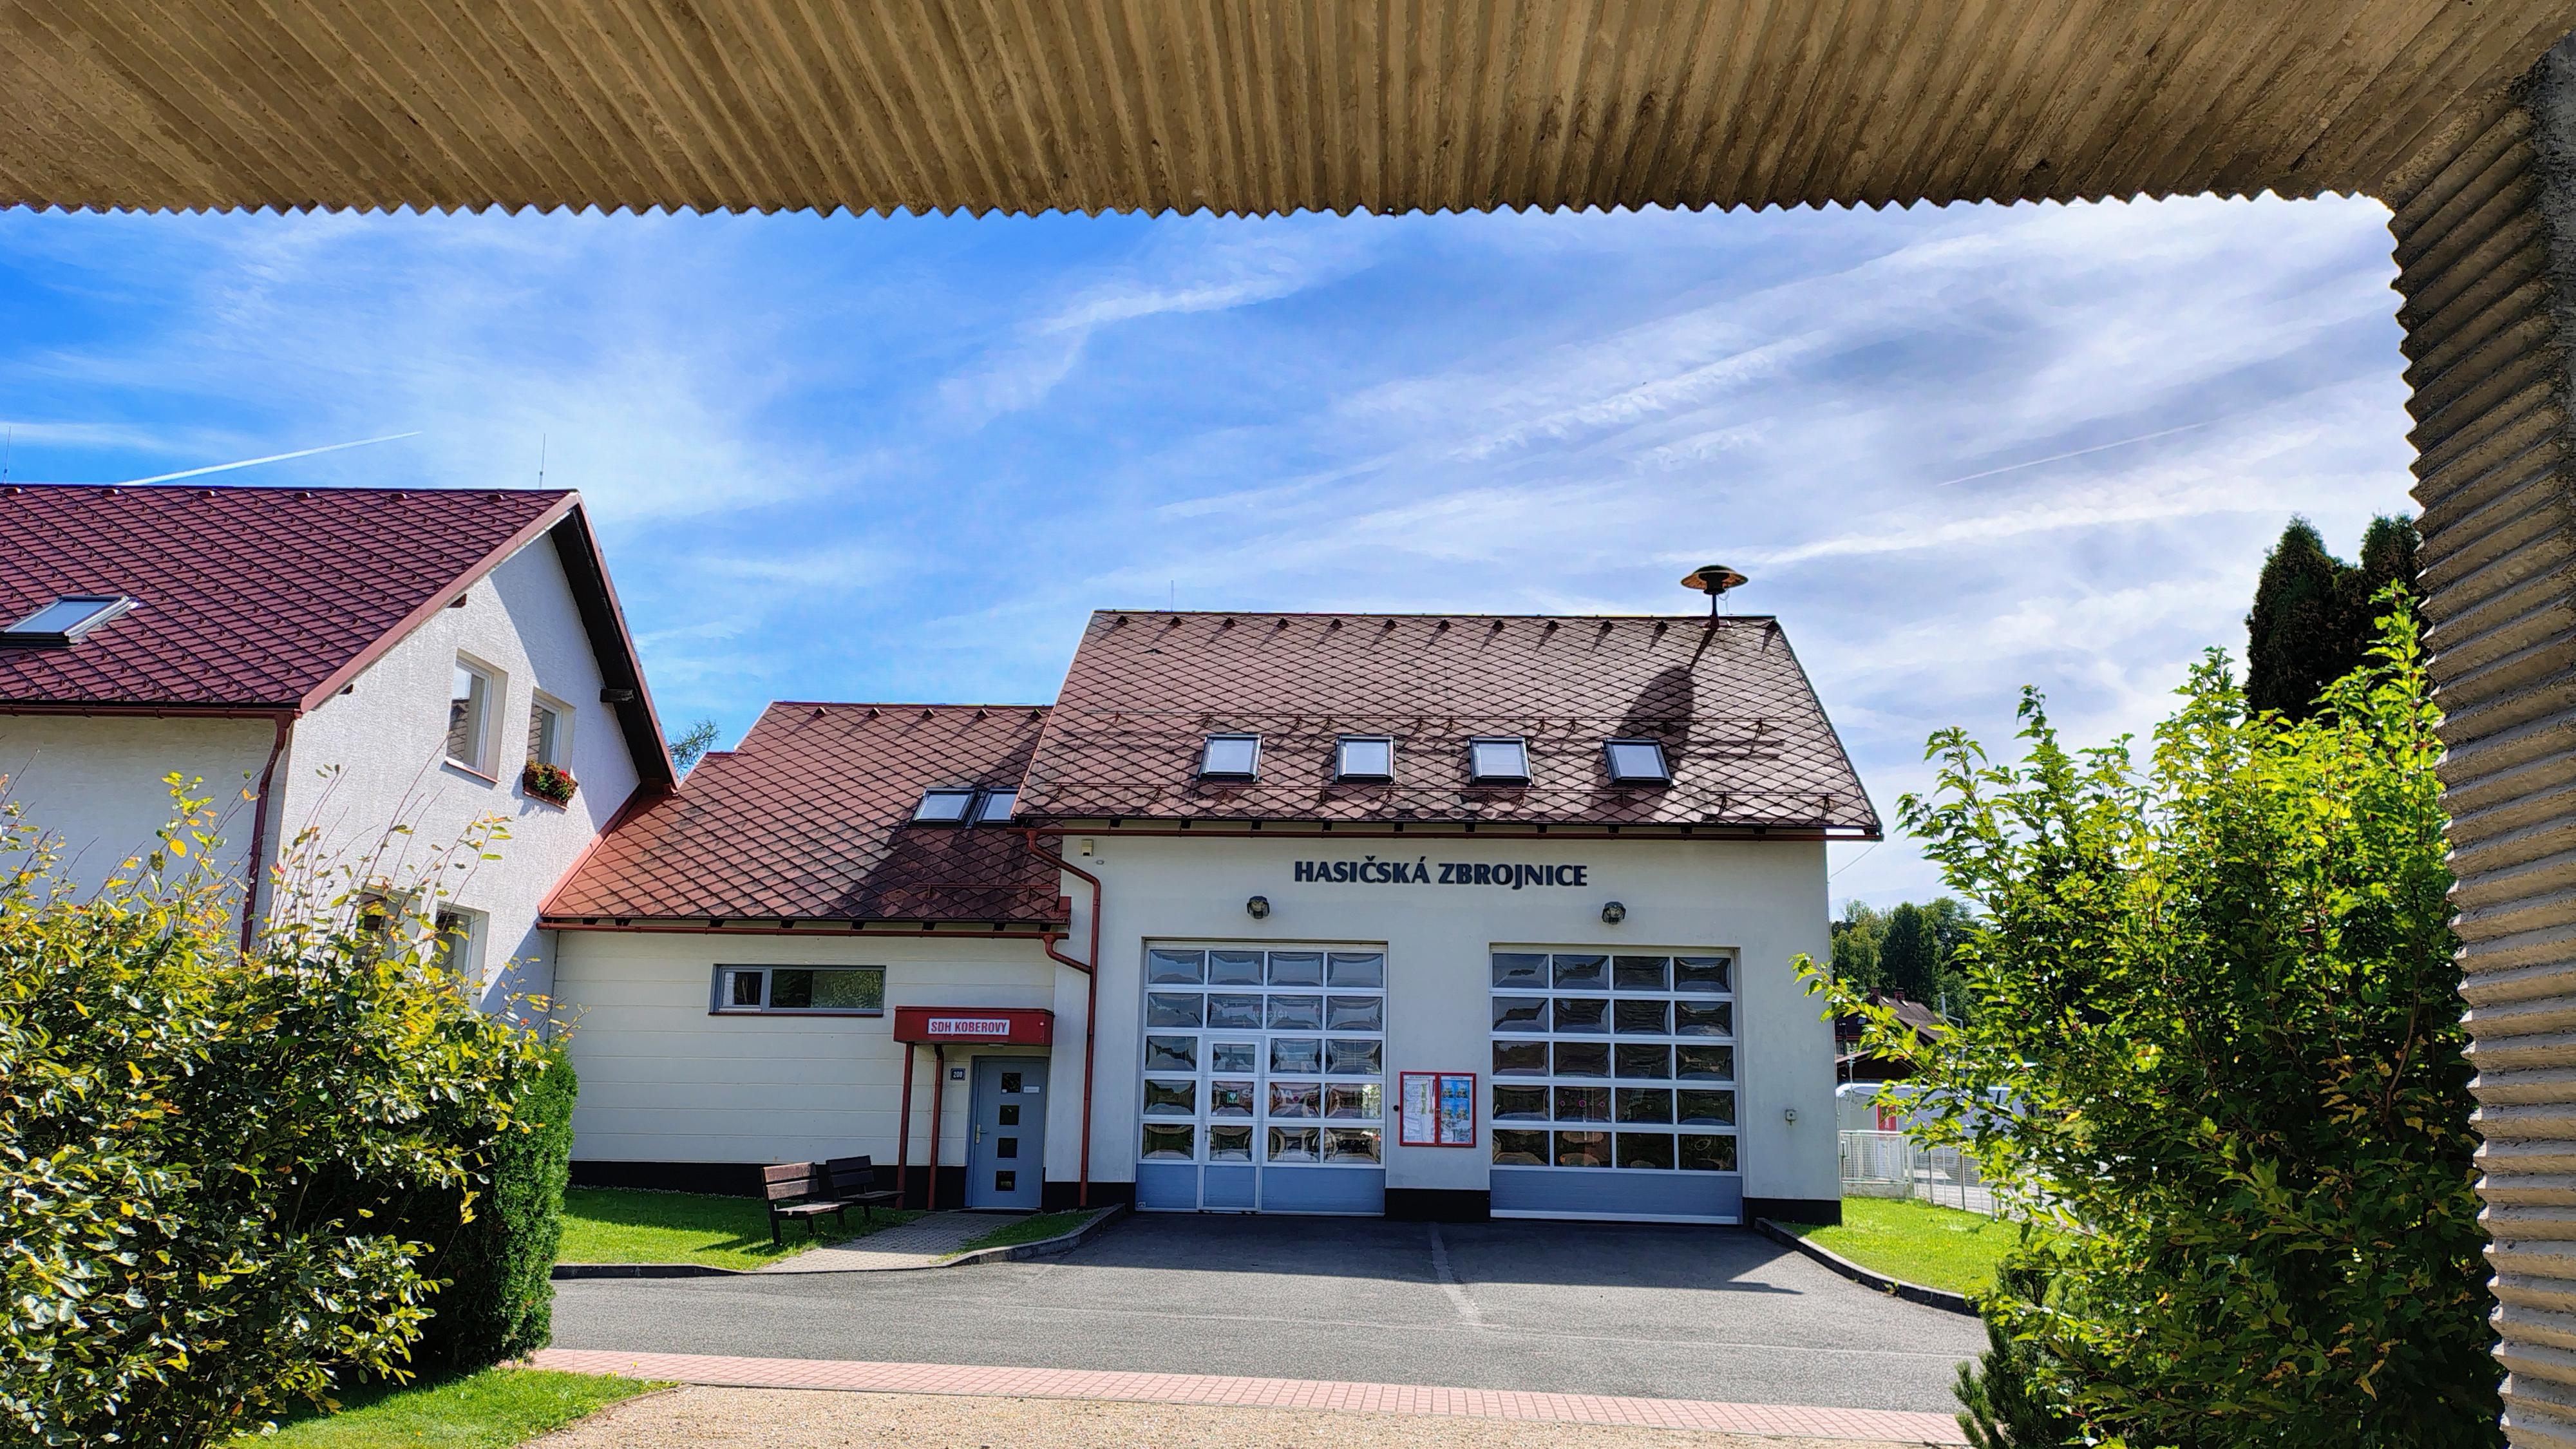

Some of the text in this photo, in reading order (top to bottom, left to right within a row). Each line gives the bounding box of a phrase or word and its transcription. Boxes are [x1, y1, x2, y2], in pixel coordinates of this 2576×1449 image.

[1294, 855, 1587, 890] HASIČSKÁ ZBROJNICE
[931, 1021, 1007, 1033] SDH KOBEROVY
